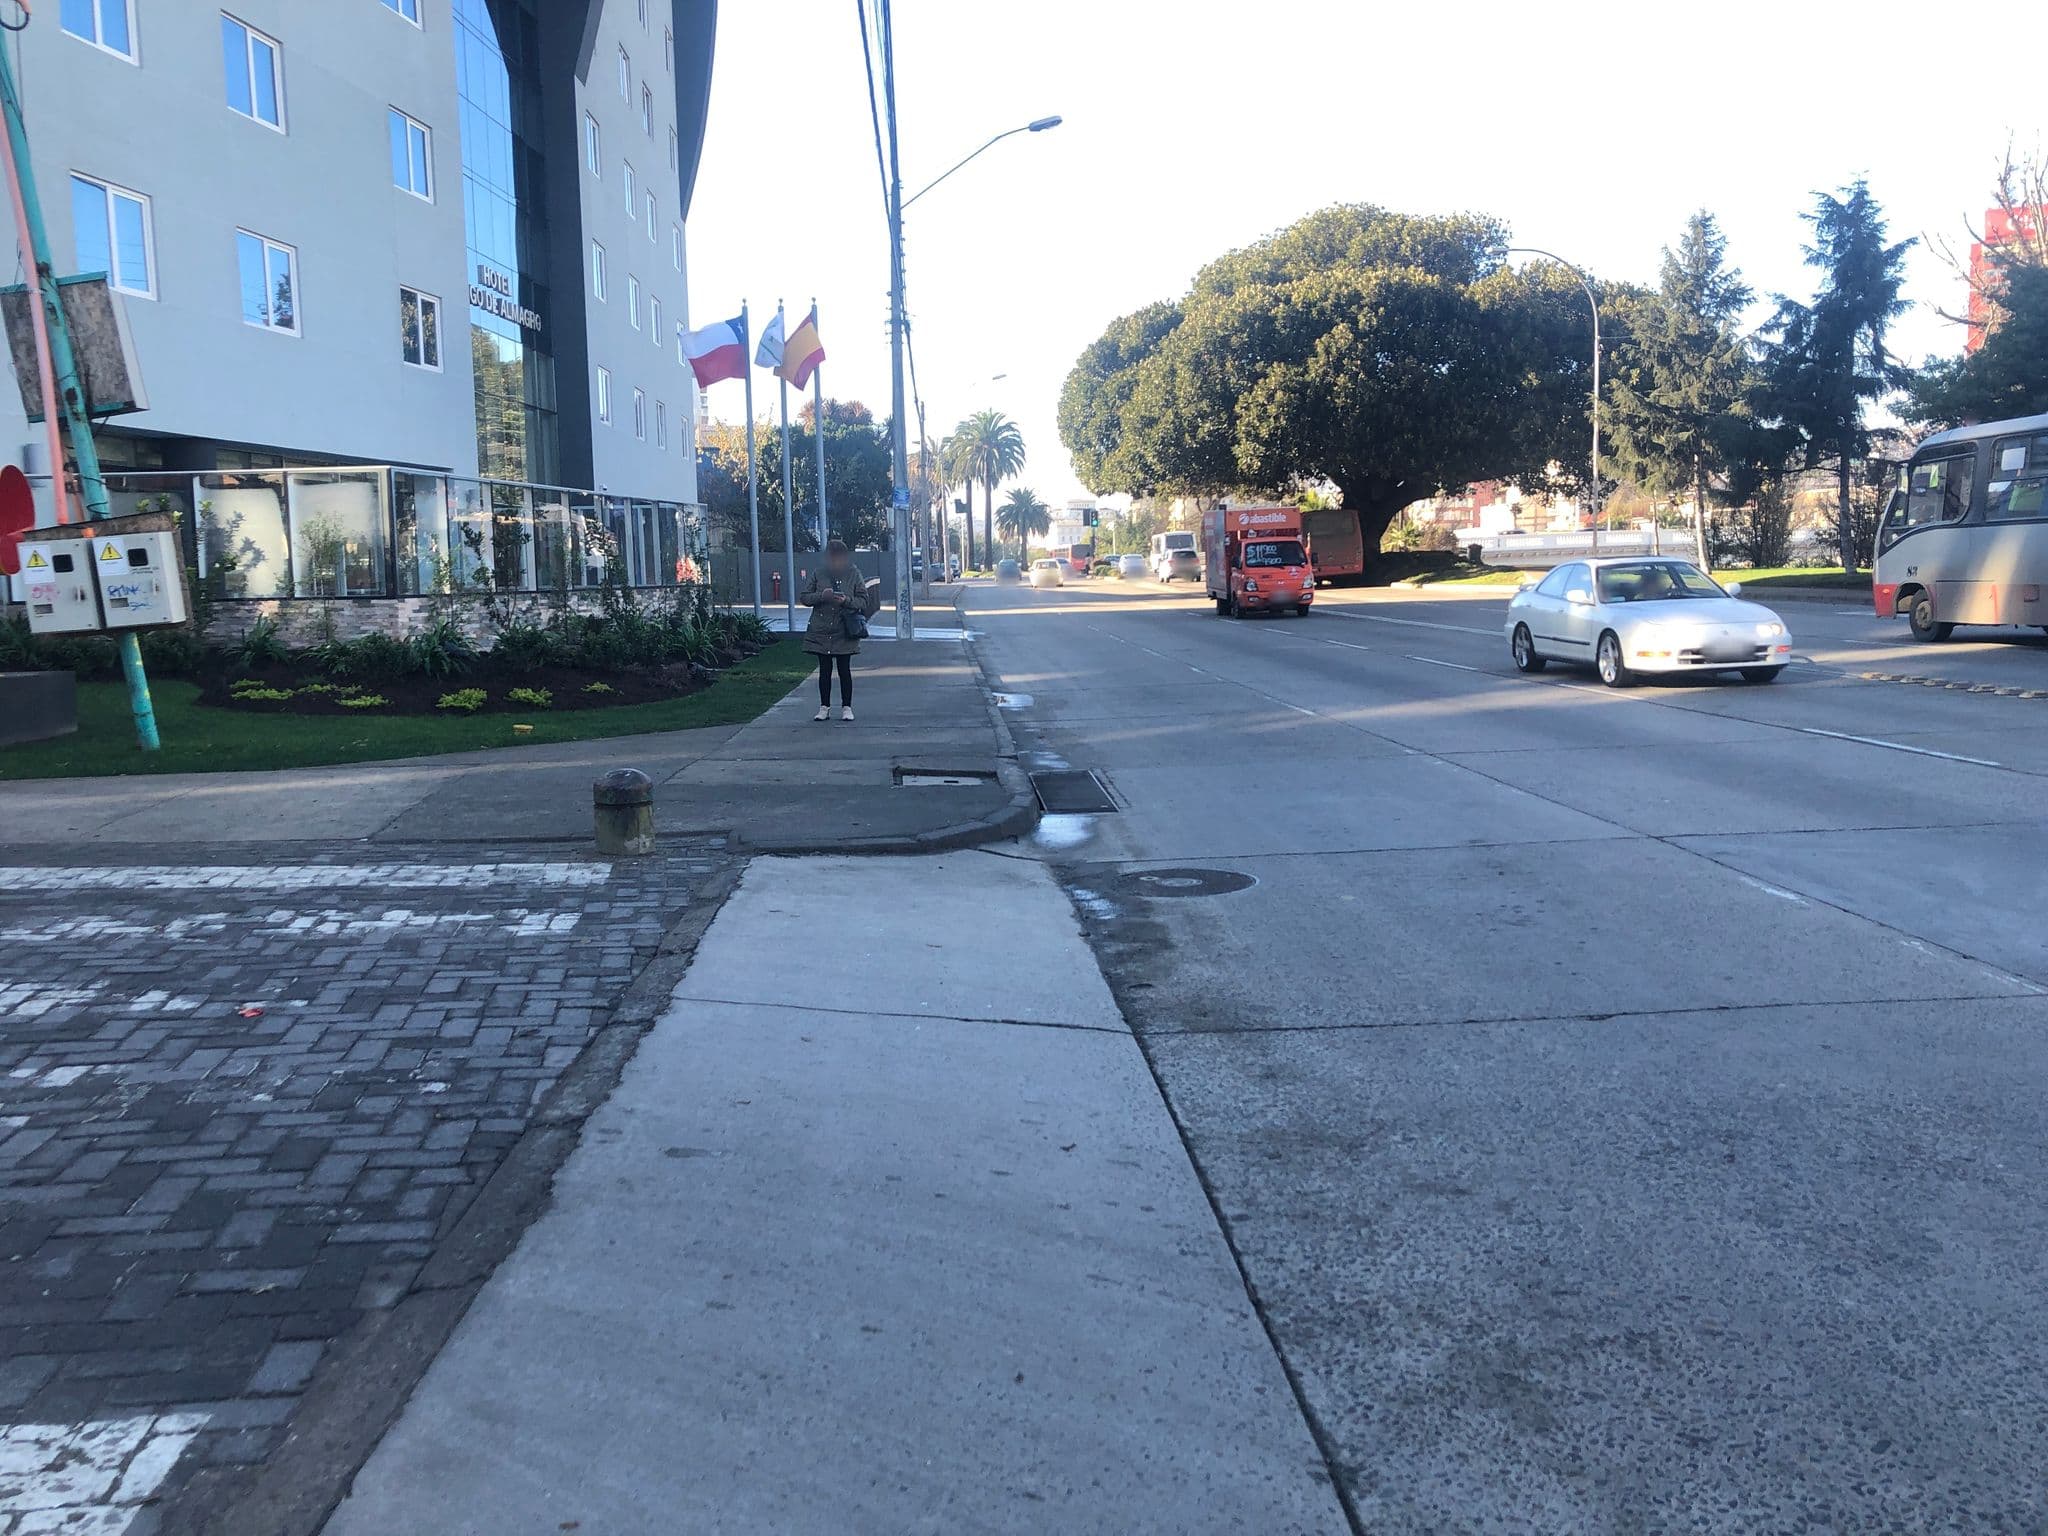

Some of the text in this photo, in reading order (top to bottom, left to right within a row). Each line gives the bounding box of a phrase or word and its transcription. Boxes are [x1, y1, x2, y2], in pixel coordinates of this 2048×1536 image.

[483, 265, 513, 297] HOTEL
[485, 293, 499, 315] DE
[500, 300, 542, 332] ALMAGRO
[1249, 513, 1287, 524] abastible
